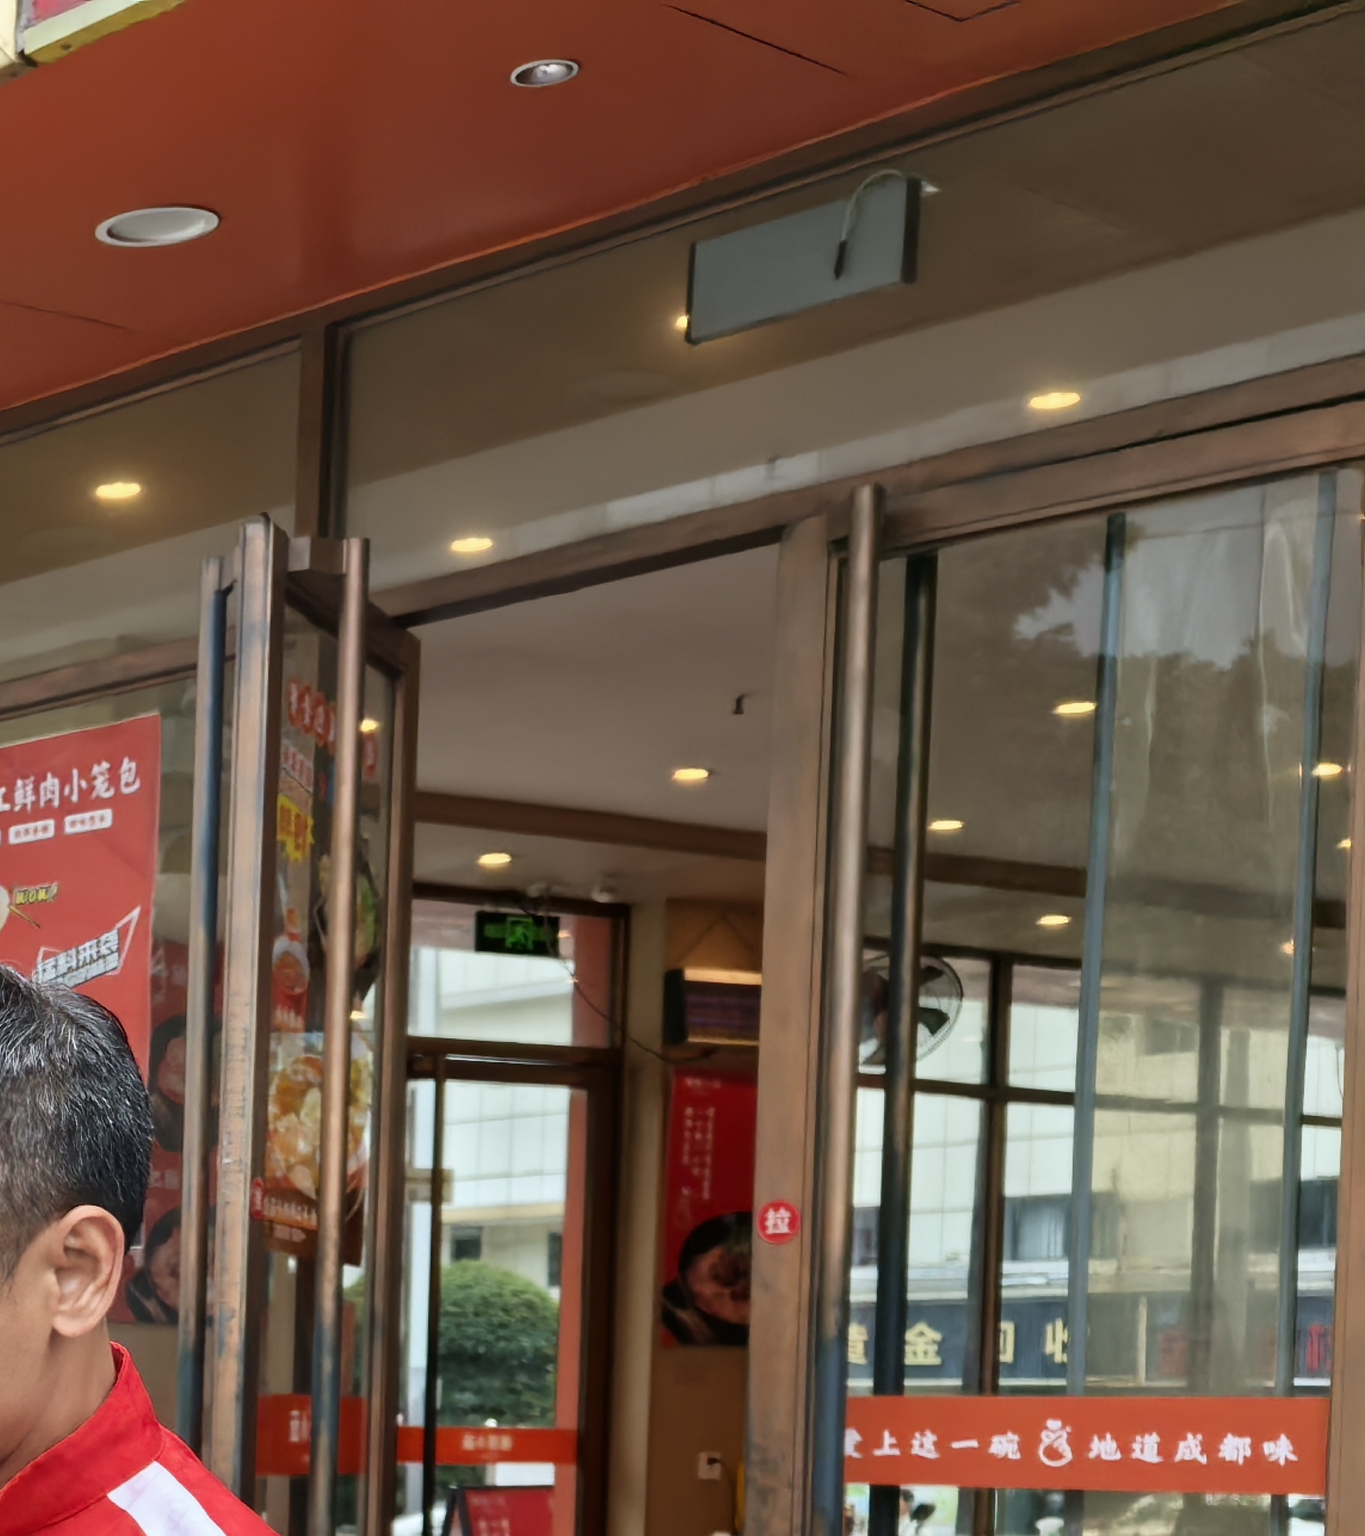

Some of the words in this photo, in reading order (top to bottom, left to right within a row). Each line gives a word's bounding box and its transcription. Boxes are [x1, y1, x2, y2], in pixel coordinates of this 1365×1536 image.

[763, 1207, 793, 1236] 拉
[1088, 1432, 1299, 1468] 地道成都味
